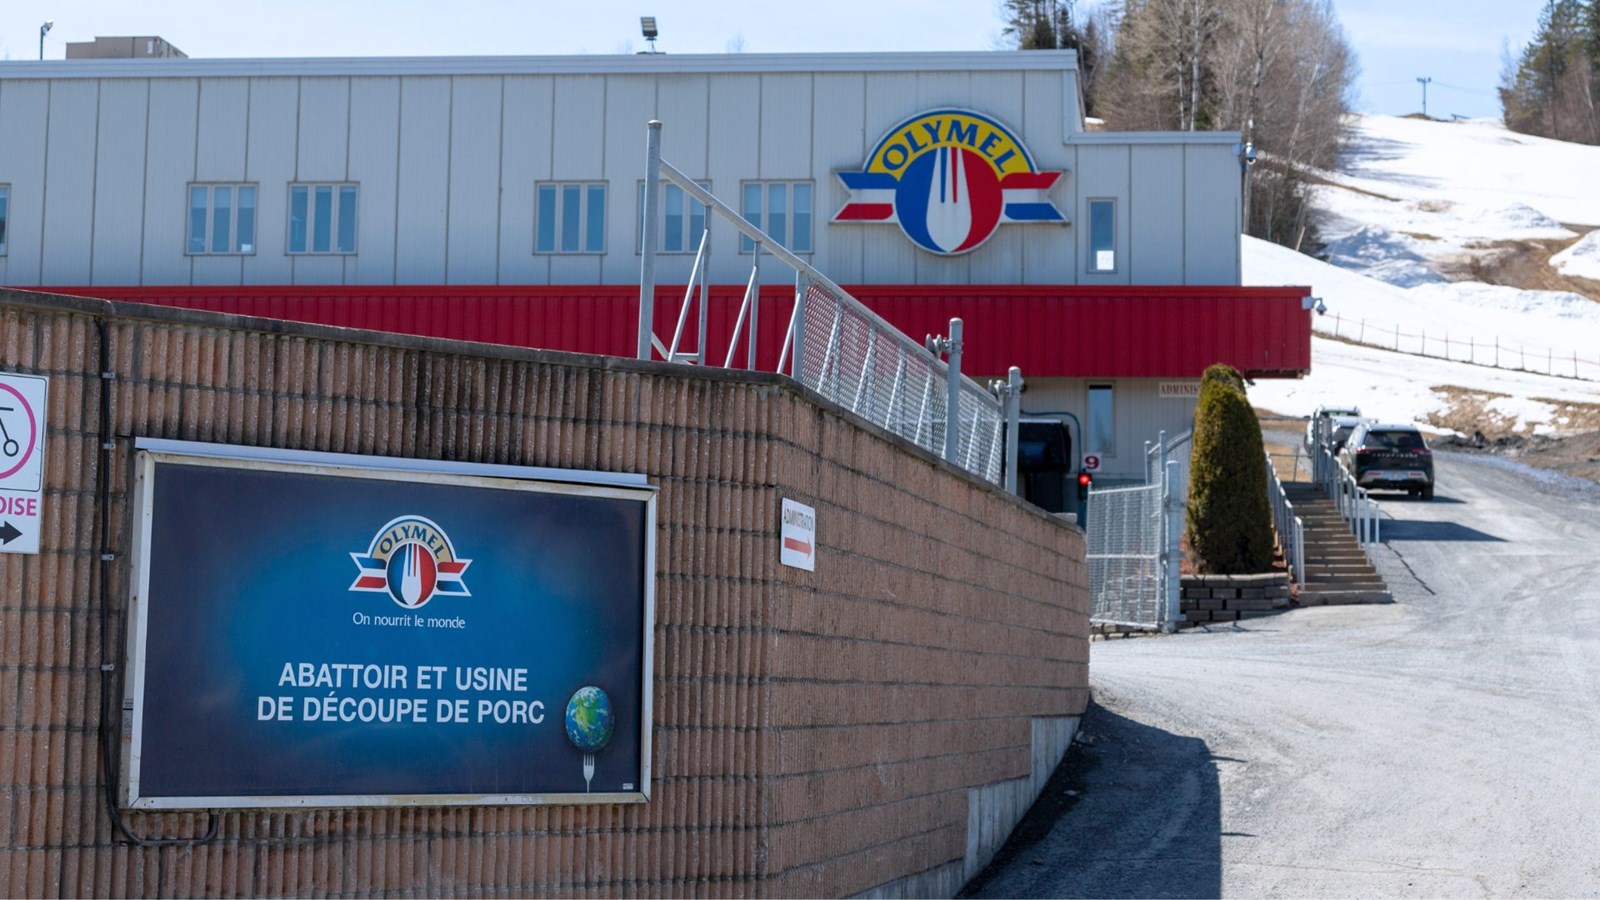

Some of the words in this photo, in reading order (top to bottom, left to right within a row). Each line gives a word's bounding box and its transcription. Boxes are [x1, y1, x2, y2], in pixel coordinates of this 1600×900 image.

[882, 119, 1017, 173] OLYMEL
[1161, 384, 1200, 395] ADMINIS
[1084, 455, 1100, 470] 9
[380, 525, 445, 559] OLYMEL
[352, 612, 371, 625] On
[374, 614, 411, 626] nourrit
[414, 615, 424, 627] le
[427, 616, 466, 629] monde
[278, 662, 408, 689] ABATTOIR
[416, 666, 448, 689] ET
[455, 666, 528, 692] USINE
[257, 696, 294, 721] DE
[302, 691, 428, 723] DÉCOUPE
[436, 699, 469, 723] DE
[477, 700, 545, 724] PORC
